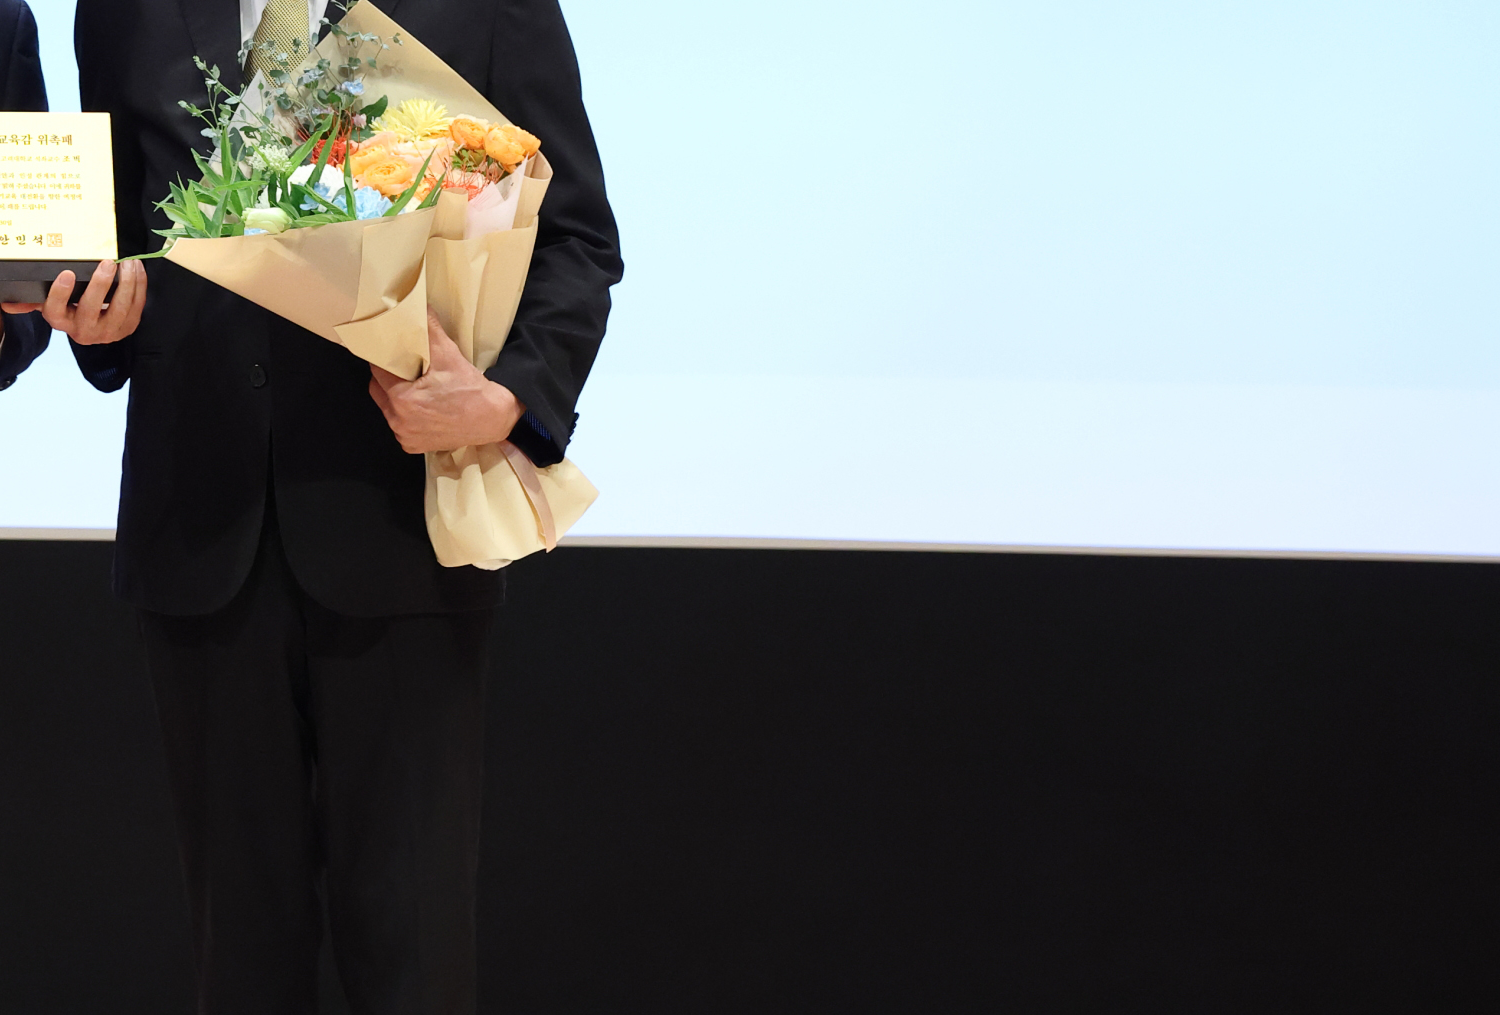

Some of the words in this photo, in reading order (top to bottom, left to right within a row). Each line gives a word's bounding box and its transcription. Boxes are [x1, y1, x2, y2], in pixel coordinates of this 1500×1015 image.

[37, 134, 73, 146] 위촉패
[15, 234, 26, 246] 민
[32, 234, 43, 246] 석
